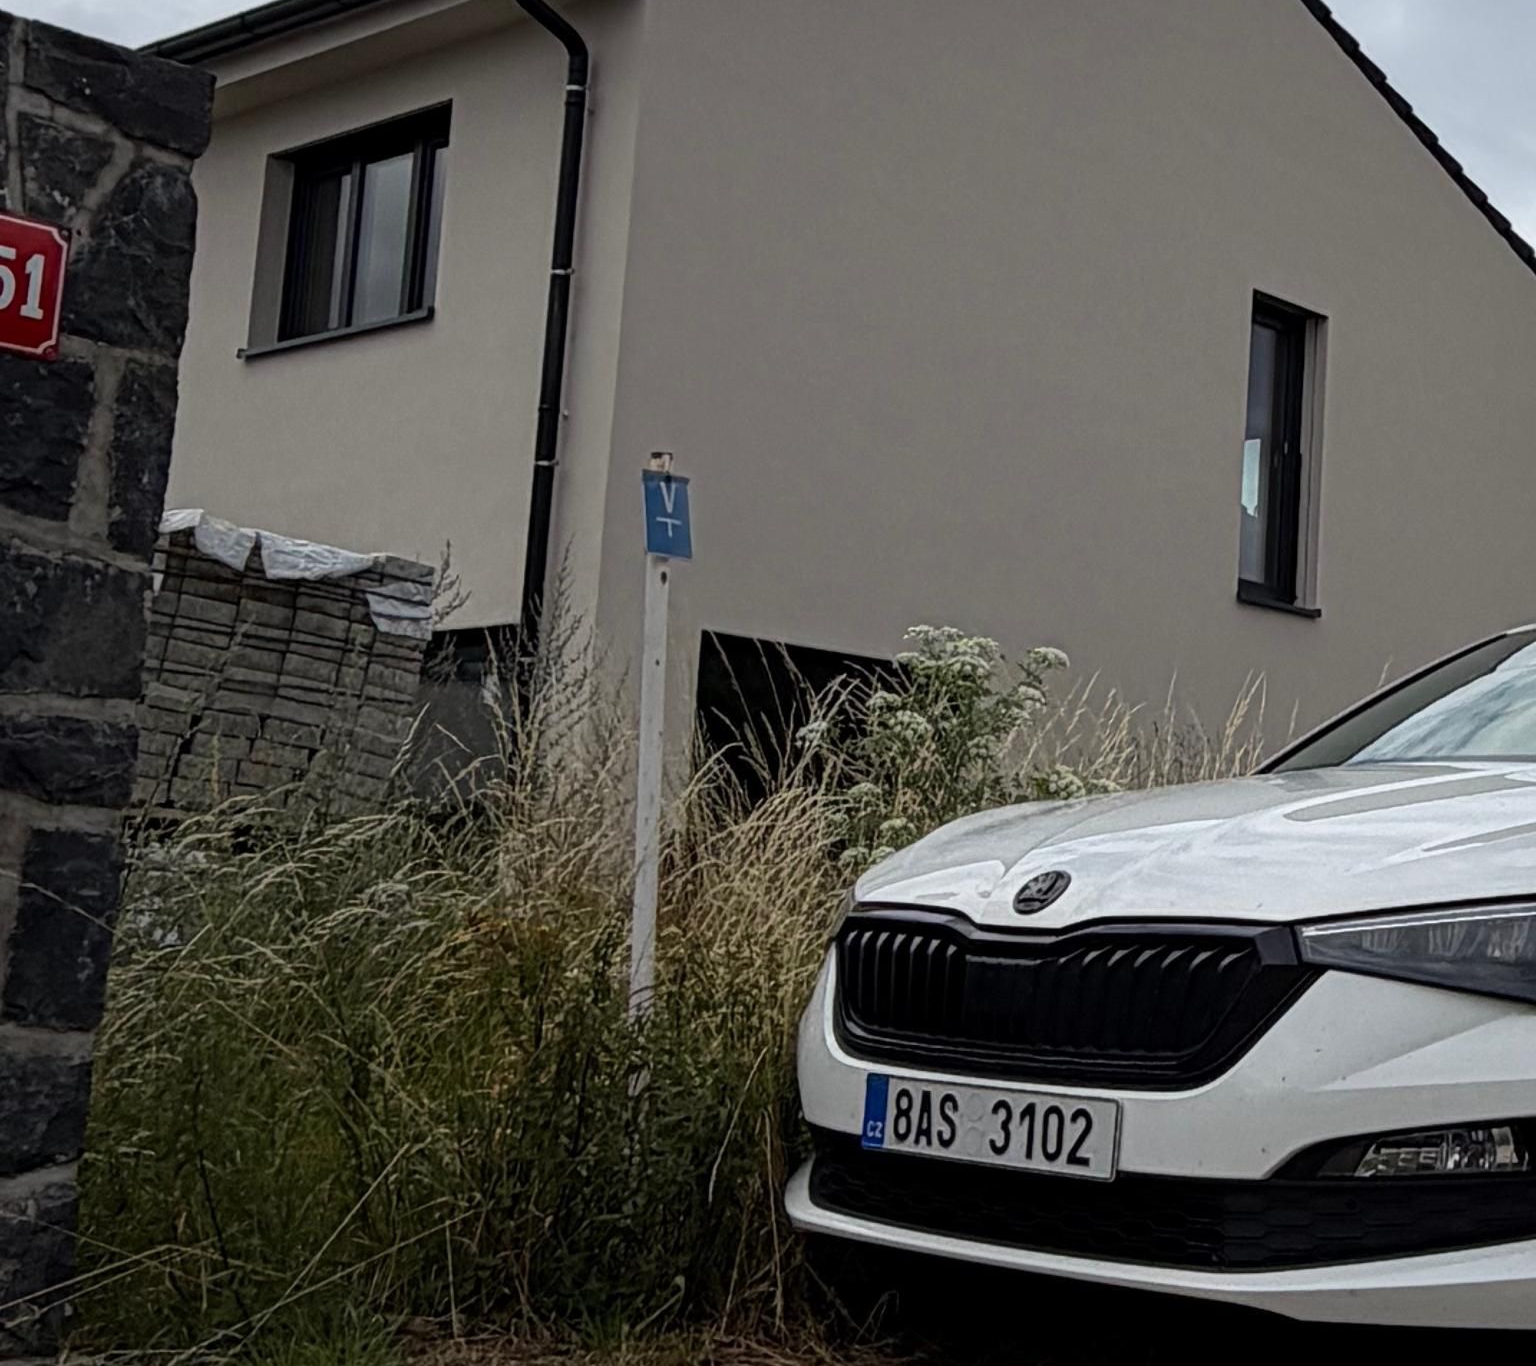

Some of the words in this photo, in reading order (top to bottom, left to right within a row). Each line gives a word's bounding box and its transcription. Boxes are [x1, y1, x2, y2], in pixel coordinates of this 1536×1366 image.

[867, 1120, 883, 1138] CZ
[893, 1088, 959, 1148] 8AS
[989, 1099, 1093, 1167] 3102
